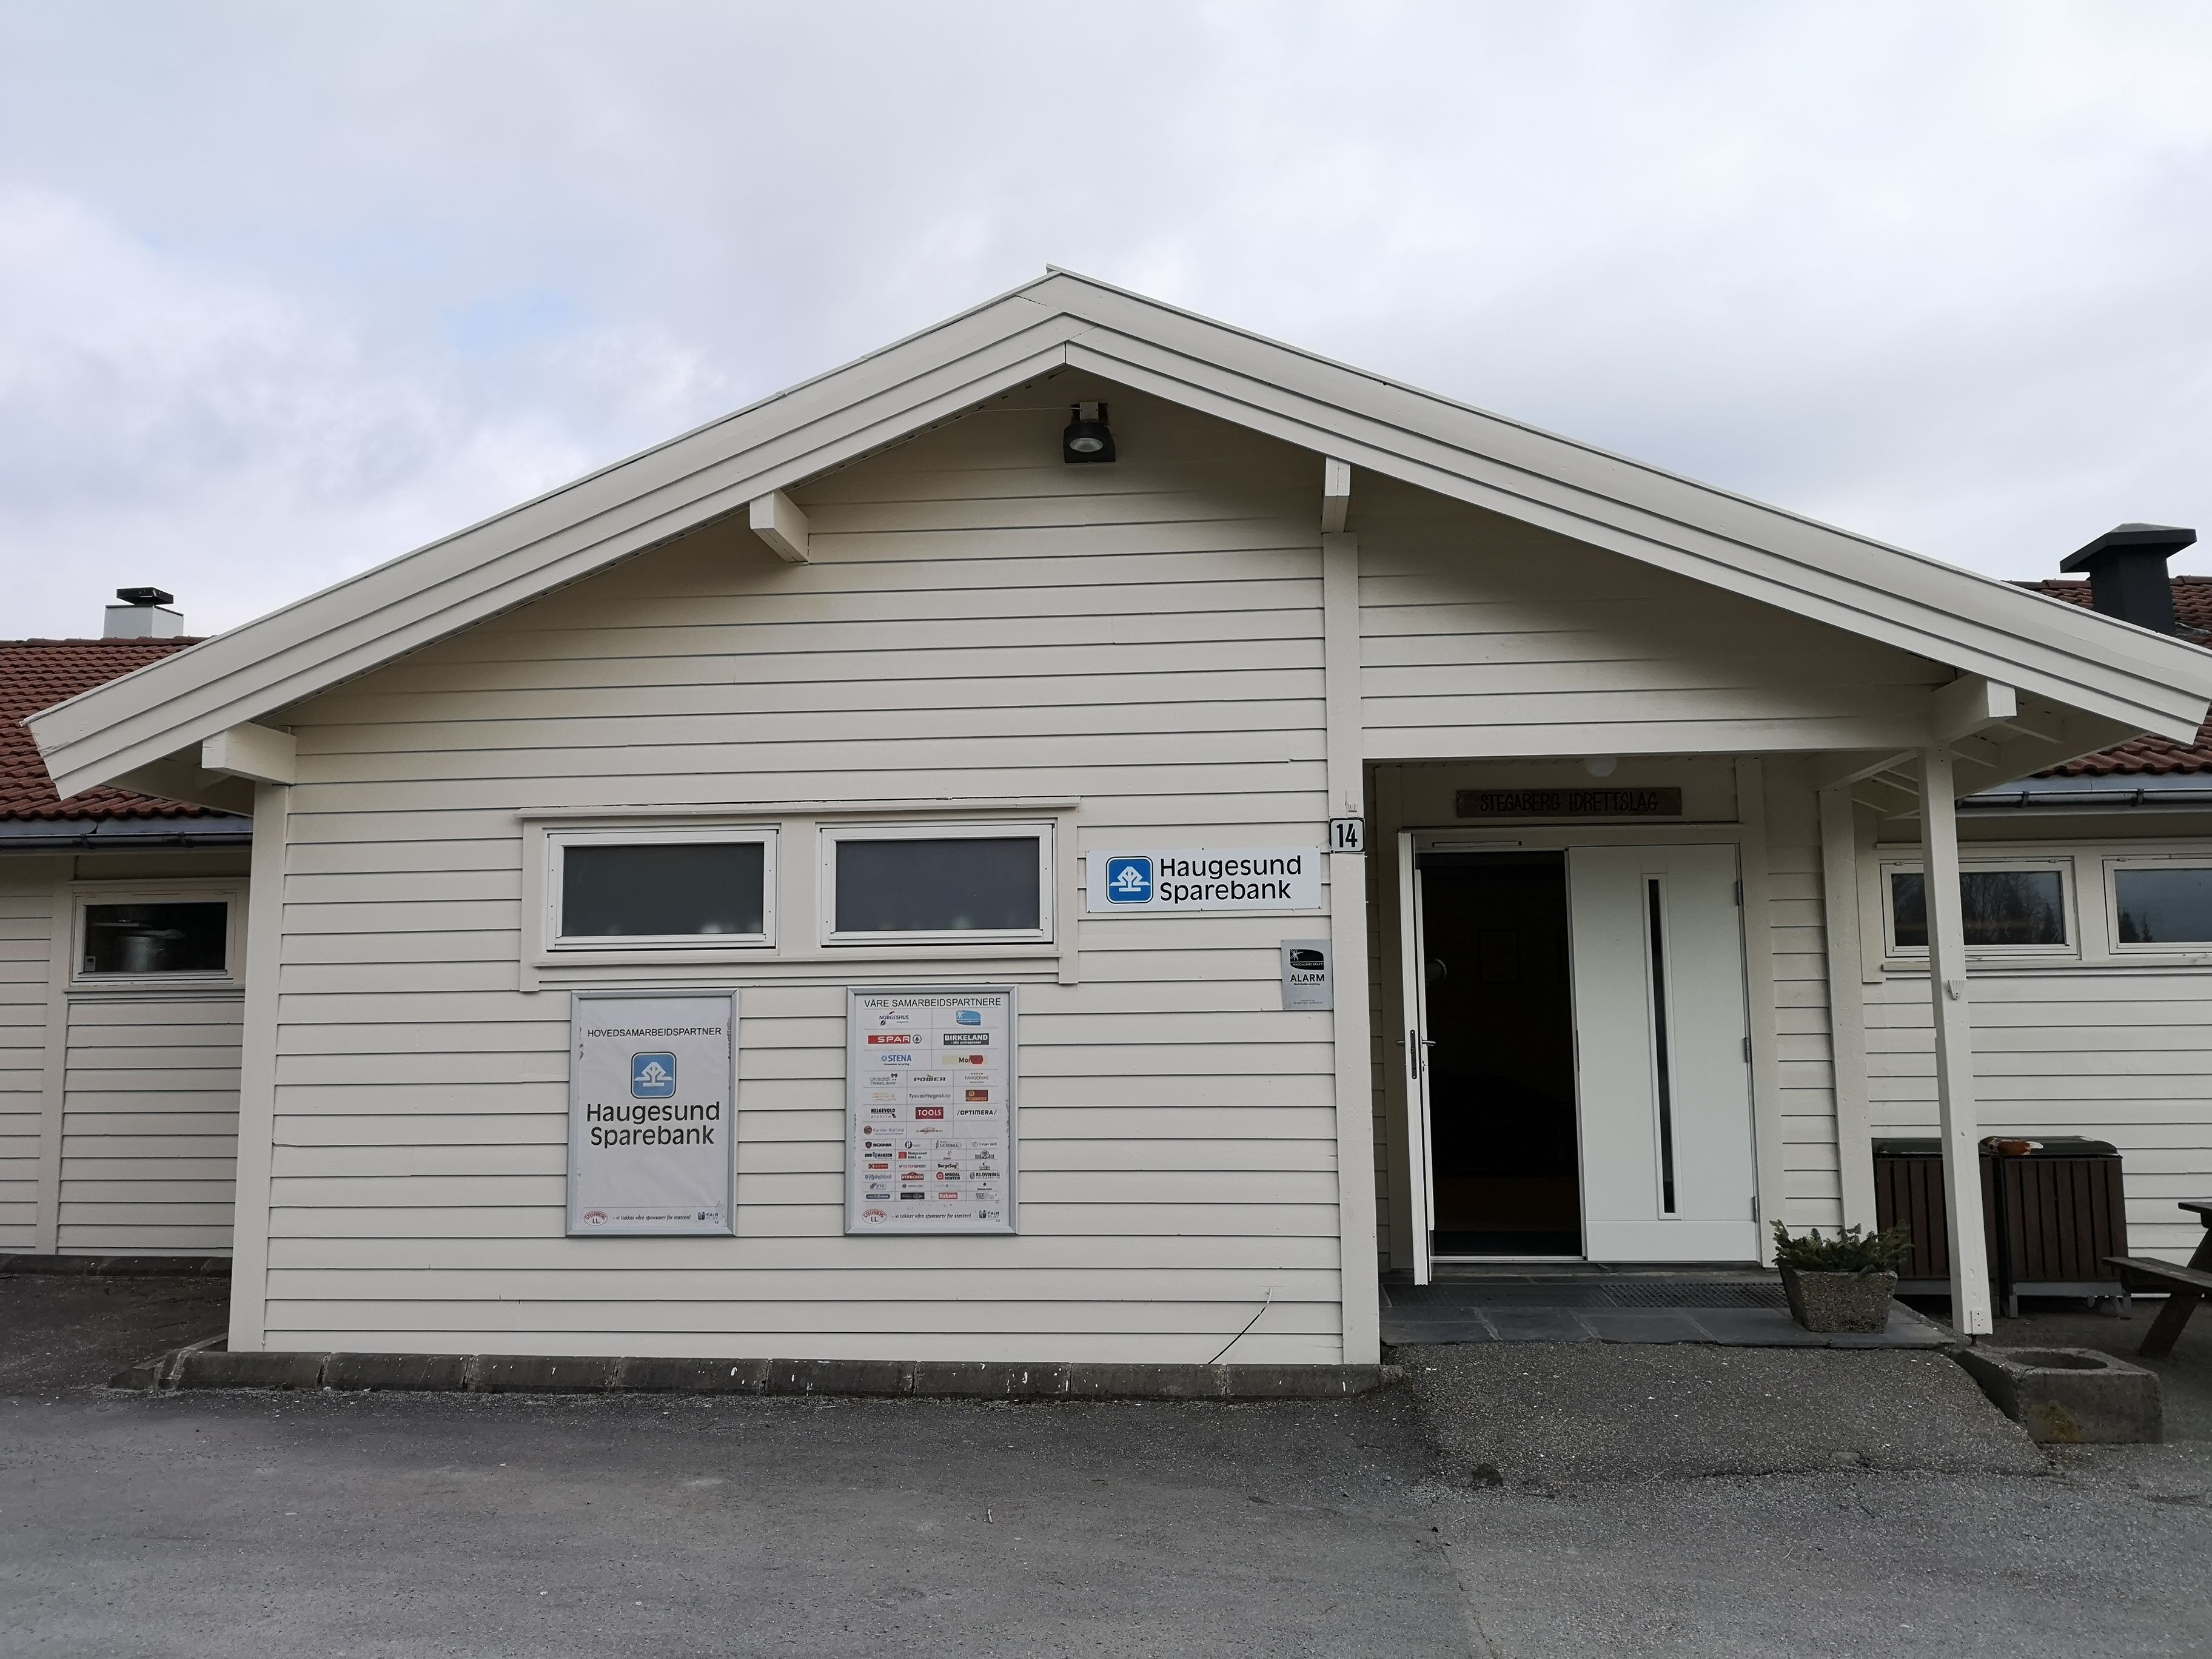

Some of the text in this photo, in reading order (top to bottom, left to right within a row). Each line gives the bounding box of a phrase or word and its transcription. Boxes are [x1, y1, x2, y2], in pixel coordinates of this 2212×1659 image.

[1480, 791, 1659, 813] STEGABERG IDRETTSLAG
[1336, 823, 1358, 848] 14
[1160, 856, 1302, 879] Haugesund
[1160, 879, 1292, 904] Sparebank
[865, 998, 1001, 1007] VÅRE SAMARBEIDSPARTNERE
[588, 1027, 722, 1037] HOVEDSAMARBEIDSPARTNER
[586, 1101, 720, 1125] Haugesund
[591, 1125, 715, 1149] Sparebank
[585, 1211, 606, 1220] STEGABERG
[864, 1209, 885, 1218] STEGABERG
